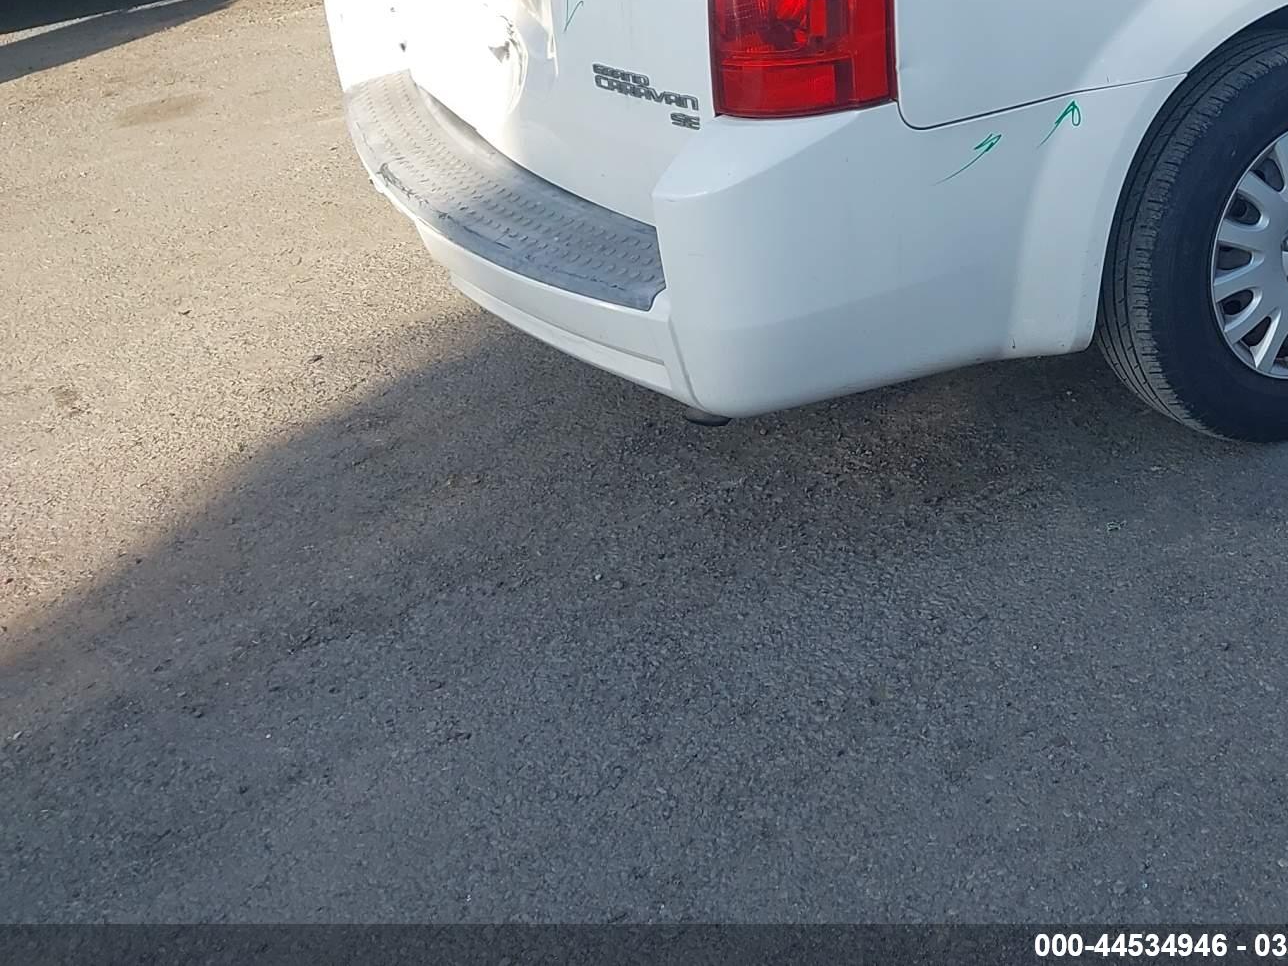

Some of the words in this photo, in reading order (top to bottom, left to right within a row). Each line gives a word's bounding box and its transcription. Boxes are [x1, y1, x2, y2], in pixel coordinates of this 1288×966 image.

[592, 63, 650, 86] GRAND
[595, 75, 699, 111] CARAVAN
[670, 113, 700, 130] SE
